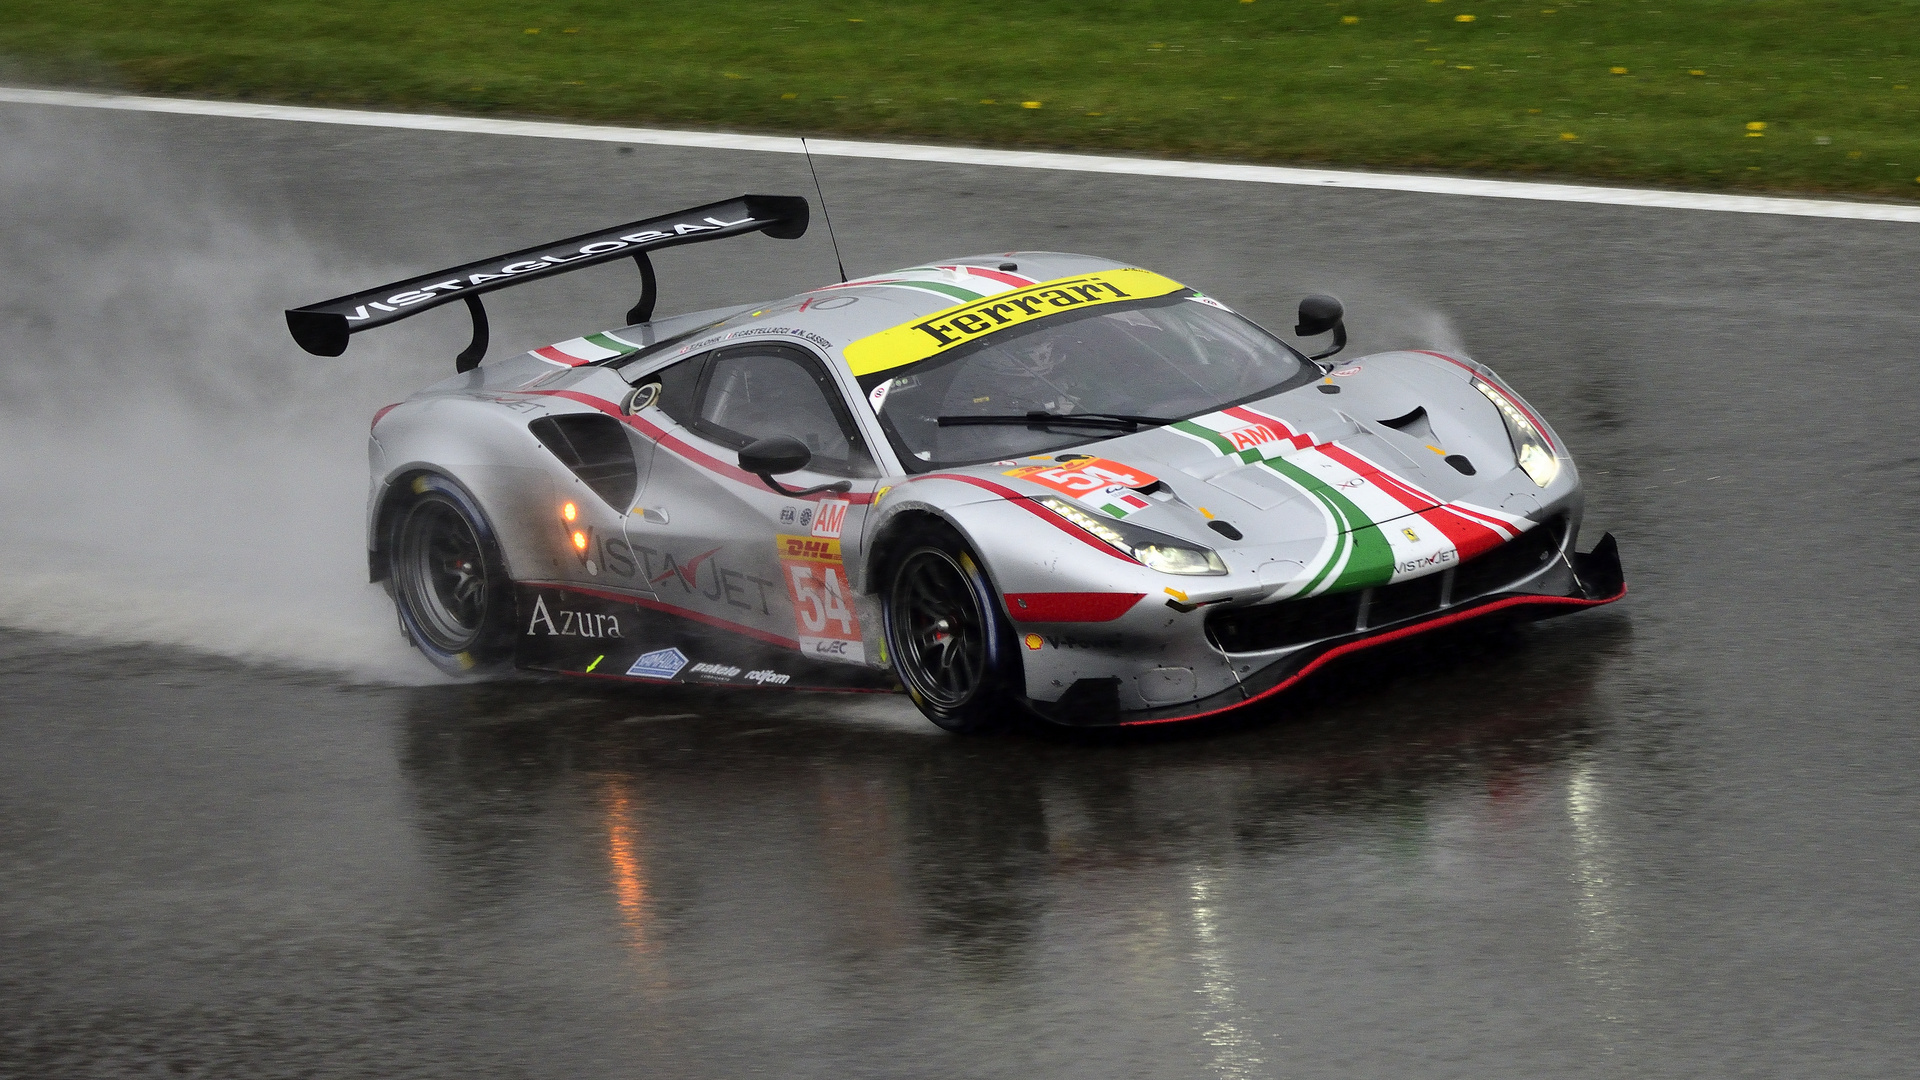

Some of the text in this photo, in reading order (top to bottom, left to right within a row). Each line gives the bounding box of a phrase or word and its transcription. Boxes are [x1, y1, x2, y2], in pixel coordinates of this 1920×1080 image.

[346, 216, 755, 322] VISTAGLOBAL
[911, 278, 1131, 348] Ferrari
[1230, 425, 1277, 450] AM
[1035, 466, 1140, 490] 54
[780, 509, 795, 521] FIA
[814, 503, 846, 532] AM
[786, 539, 833, 559] DHL
[789, 566, 854, 635] 54
[527, 594, 625, 638] Azura
[816, 640, 848, 655] WEC
[689, 662, 741, 677] pakelo
